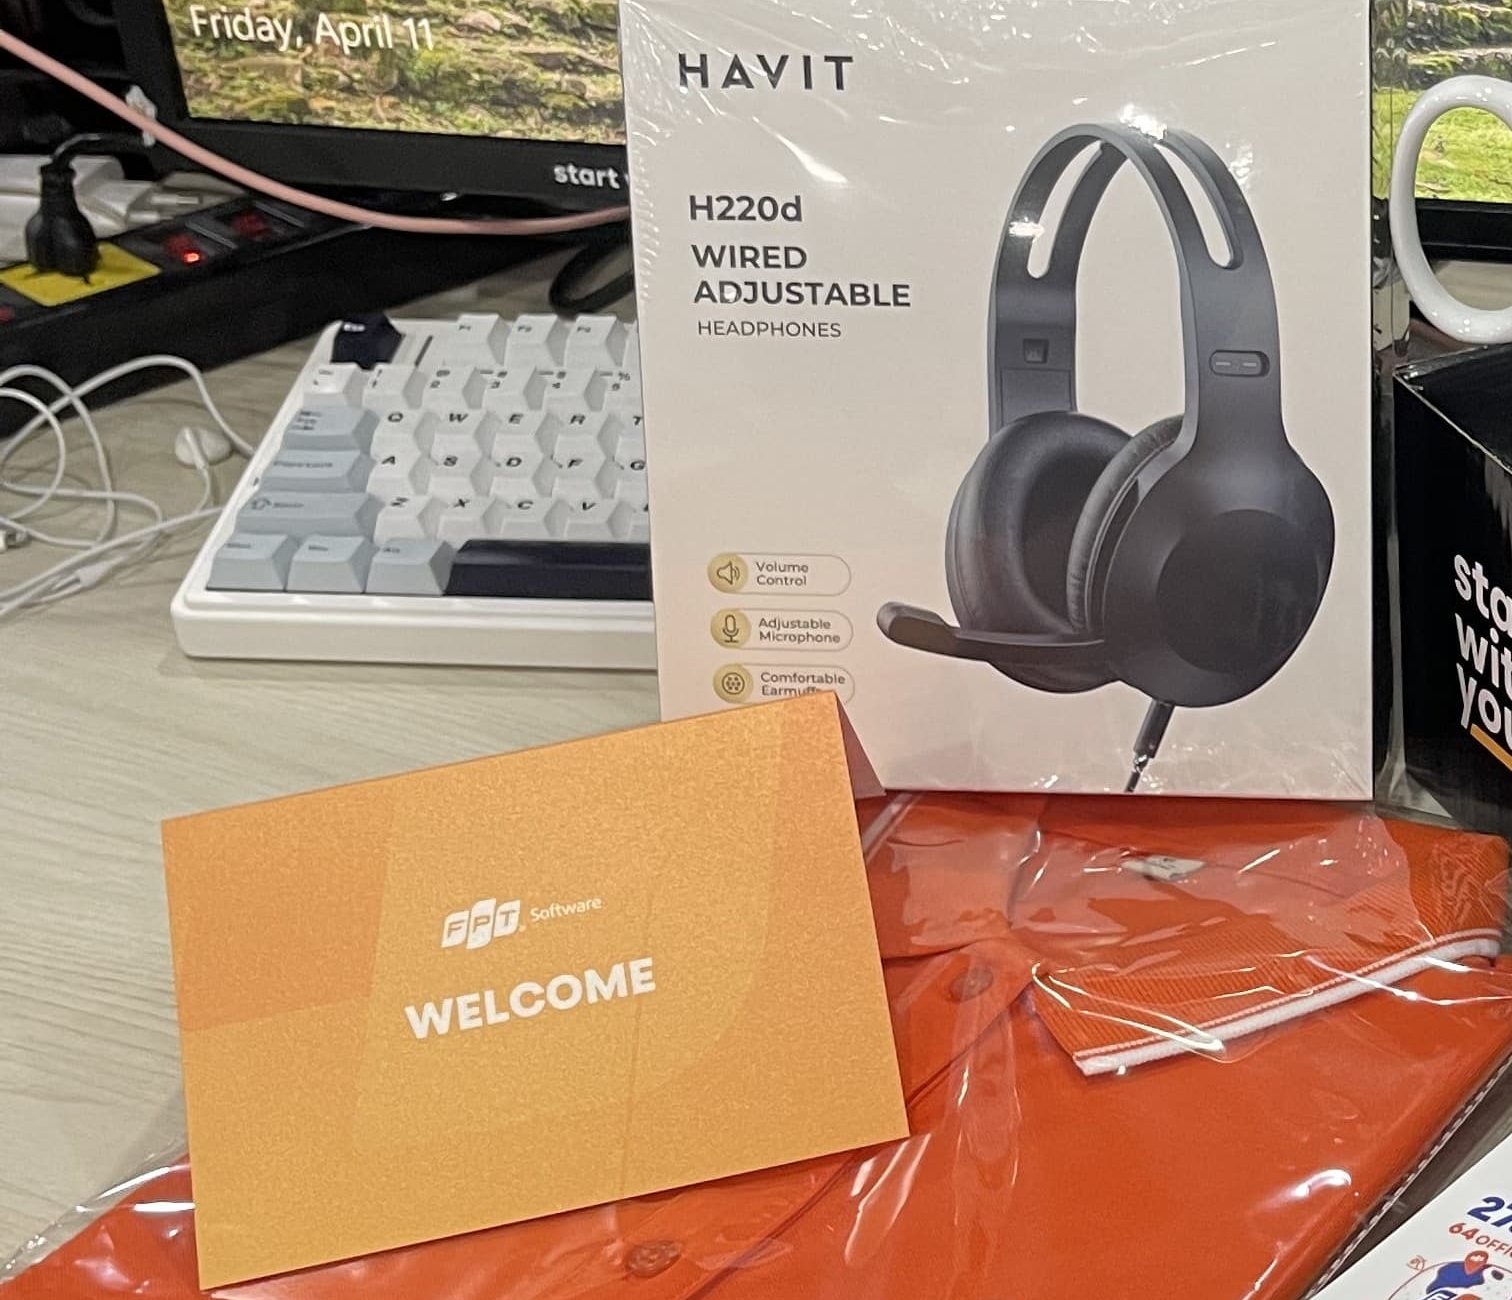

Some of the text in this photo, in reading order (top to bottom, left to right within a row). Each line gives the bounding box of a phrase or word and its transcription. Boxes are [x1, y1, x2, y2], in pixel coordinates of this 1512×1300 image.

[190, 6, 433, 54] Friday, April 11
[679, 53, 853, 90] HAVIT
[554, 164, 620, 189] start
[690, 195, 802, 222] H220d
[691, 245, 807, 269] WIRED
[694, 281, 911, 307] ADJUSTABLE
[698, 321, 841, 337] HEADPHONES
[449, 413, 468, 423] W
[508, 413, 524, 424] E
[569, 414, 586, 425] R
[382, 455, 396, 466] A
[567, 459, 583, 468] F
[453, 498, 470, 508] X
[517, 500, 534, 510] C
[756, 561, 809, 573] Volume
[756, 574, 807, 586] Control
[758, 617, 831, 630] Adjustable
[759, 631, 840, 644] Microphone
[760, 671, 846, 685] Comfortable
[444, 898, 602, 943] FPT Software
[404, 957, 656, 1039] WELCOME
